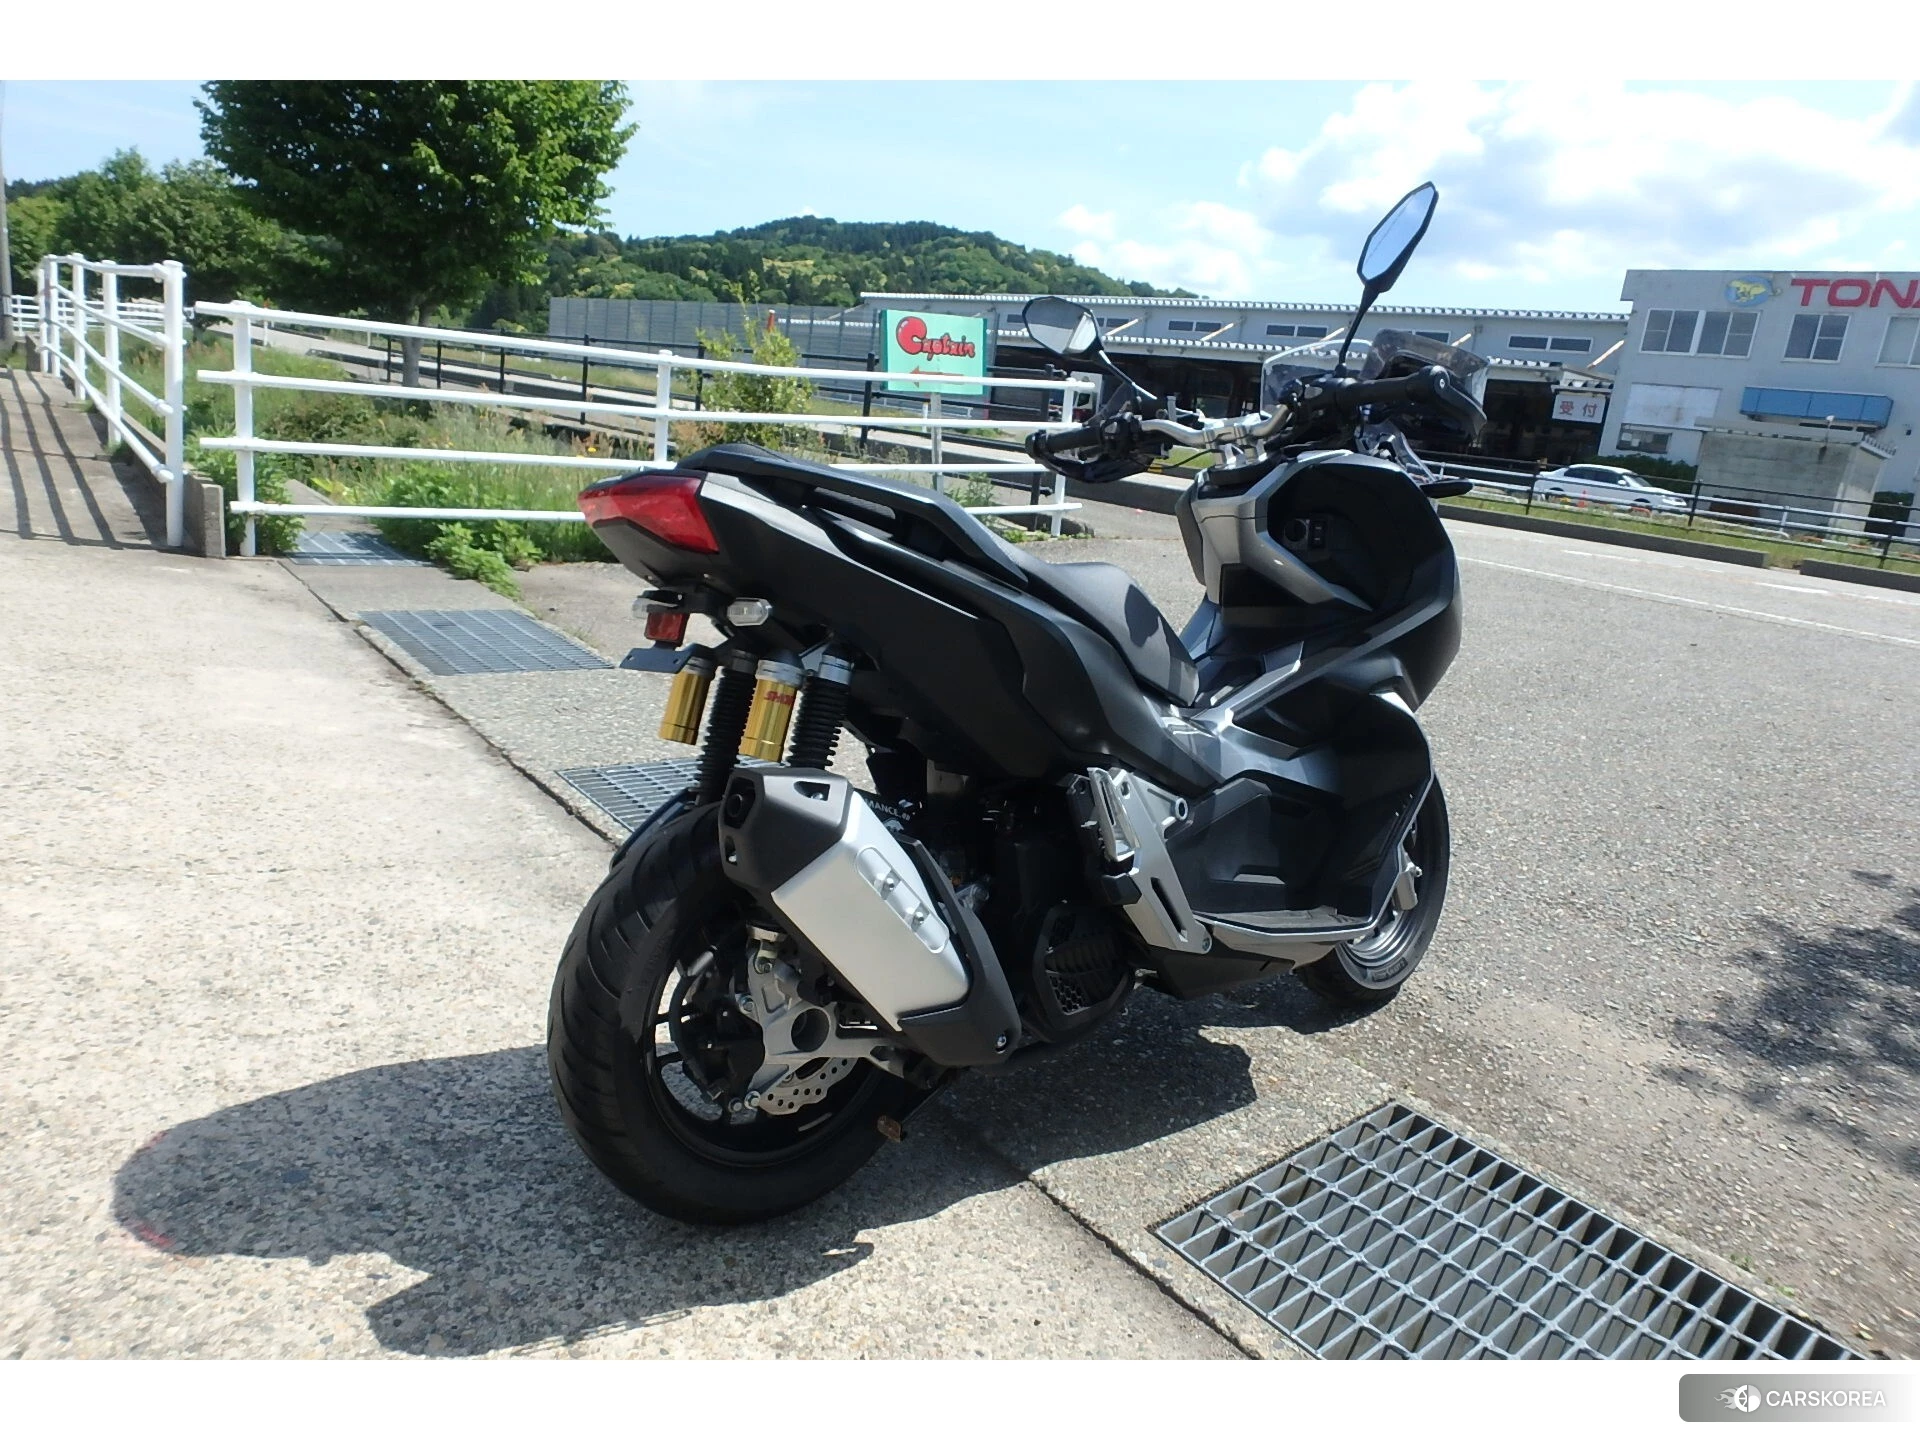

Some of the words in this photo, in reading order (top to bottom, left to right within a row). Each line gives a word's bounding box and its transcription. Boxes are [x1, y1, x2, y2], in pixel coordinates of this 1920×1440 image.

[1791, 278, 1920, 309] TON
[895, 316, 976, 361] Captain
[1559, 400, 1598, 418] 受付
